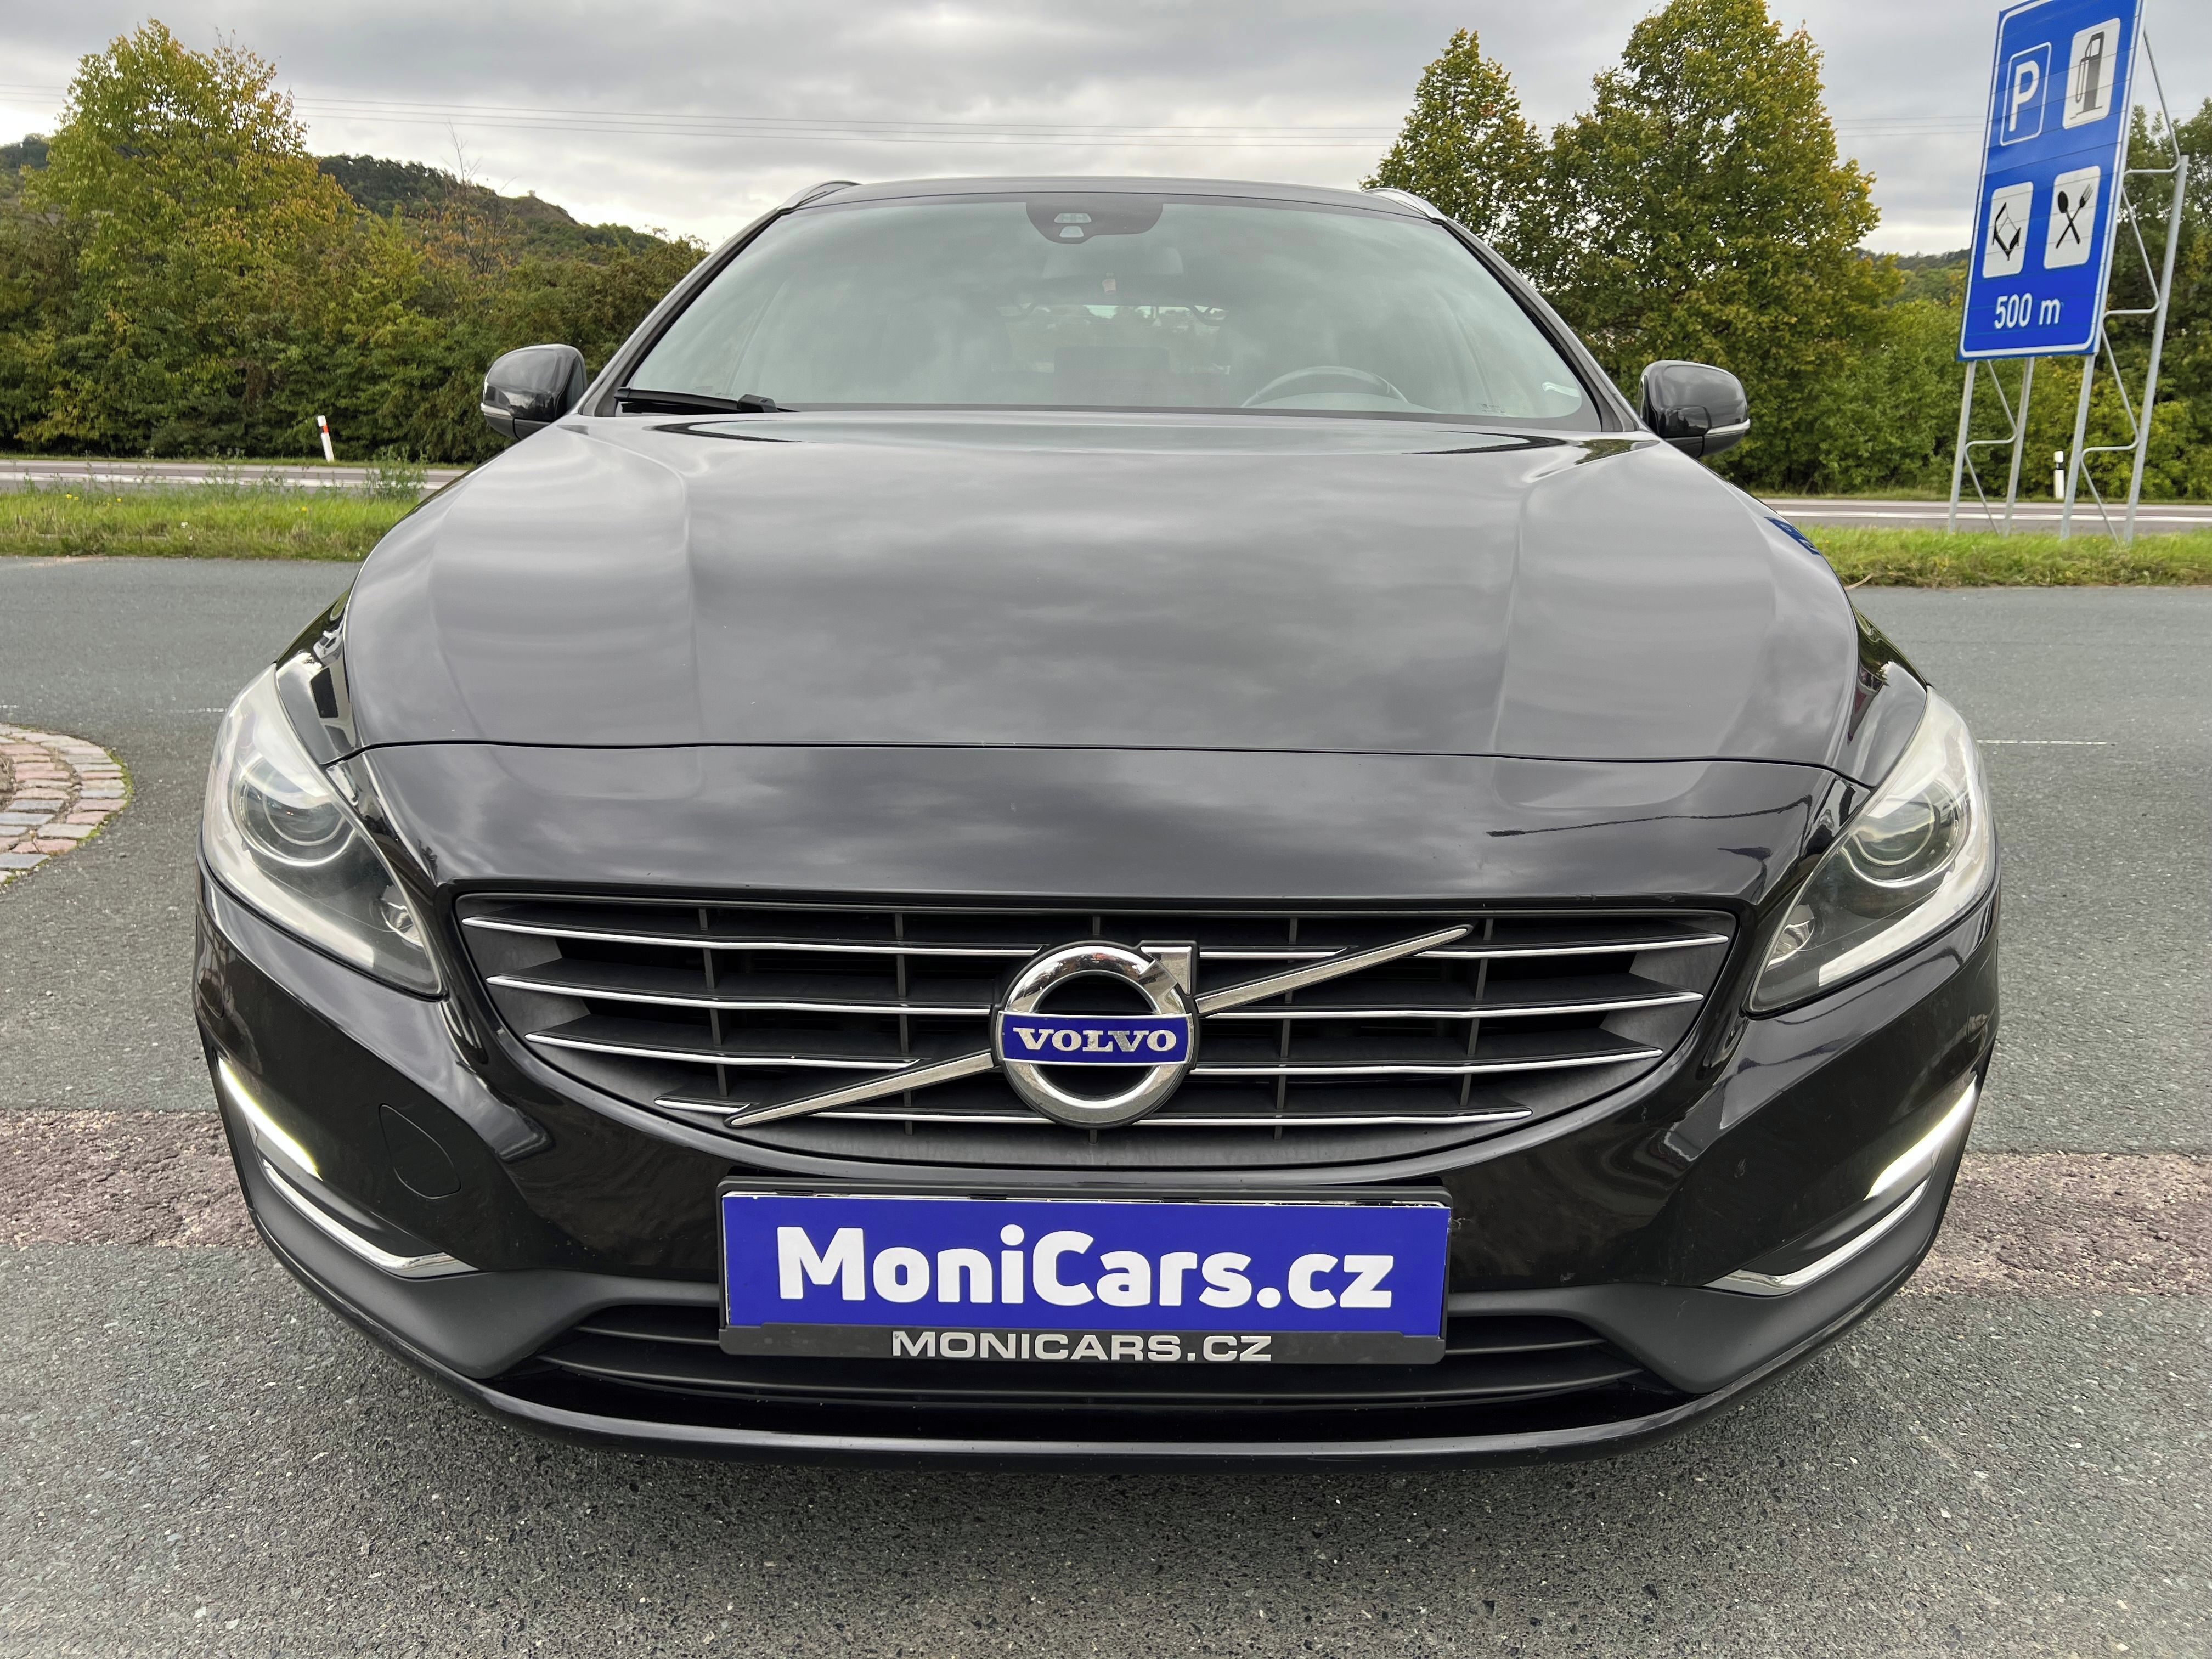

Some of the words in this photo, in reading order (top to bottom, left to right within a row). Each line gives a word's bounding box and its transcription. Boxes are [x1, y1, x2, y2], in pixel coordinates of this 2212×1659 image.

[2008, 60, 2040, 132] P
[1994, 292, 2033, 329] 500
[2039, 298, 2061, 325] m
[1013, 1027, 1177, 1052] VOLVO
[777, 1224, 1394, 1309] MoniCars.cz
[893, 1331, 1272, 1362] MONICARS.CZ
